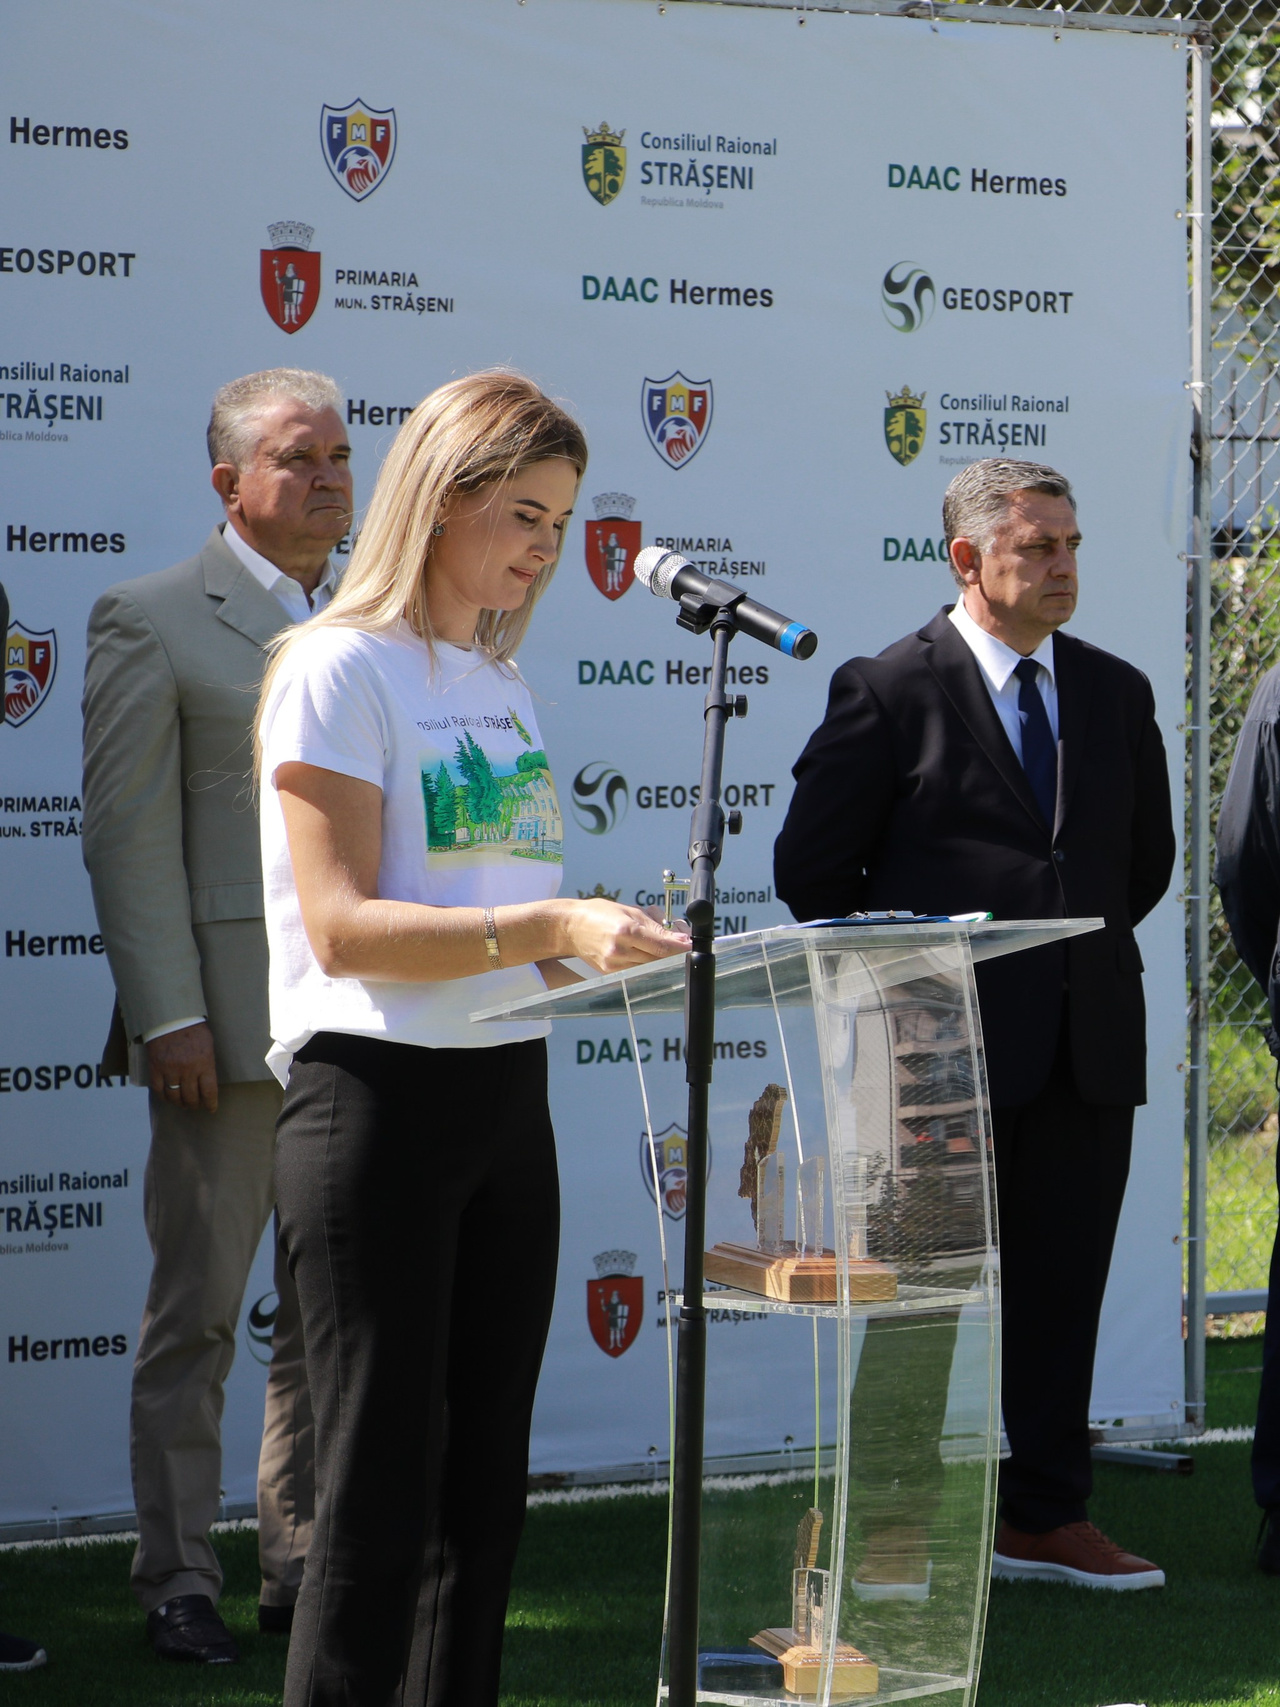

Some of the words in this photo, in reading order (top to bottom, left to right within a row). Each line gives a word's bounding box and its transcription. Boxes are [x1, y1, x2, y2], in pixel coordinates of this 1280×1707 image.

[9, 116, 129, 150] Hermes
[332, 122, 387, 142] FMF
[640, 131, 711, 152] Consiliul
[716, 135, 777, 156] Raional
[640, 158, 753, 195] STRĂȘENI
[888, 163, 961, 192] DAAC
[971, 168, 1067, 197] Hermes
[335, 269, 419, 288] PRIMARIA
[582, 275, 659, 303] DAAC
[670, 279, 774, 307] Hermes
[334, 298, 367, 310] MUN.
[370, 292, 454, 316] STRĂȘENI
[943, 287, 1074, 314] GEOSPORT
[60, 363, 129, 384] Raional
[652, 395, 703, 413] FMF
[940, 393, 1007, 411] Consiliul
[1011, 395, 1069, 413] Raional
[25, 431, 69, 442] Moldova
[939, 418, 1046, 452] STRĂȘENI
[7, 525, 126, 553] Hermes
[578, 660, 654, 685] DAAC
[636, 784, 775, 809] GEOSORT
[5, 930, 105, 957] Herme
[576, 1038, 652, 1065] DAAC
[663, 1036, 767, 1063] Hmes
[59, 1168, 128, 1192] Raional
[25, 1241, 69, 1253] Moldova
[8, 1333, 128, 1362] Hermes
